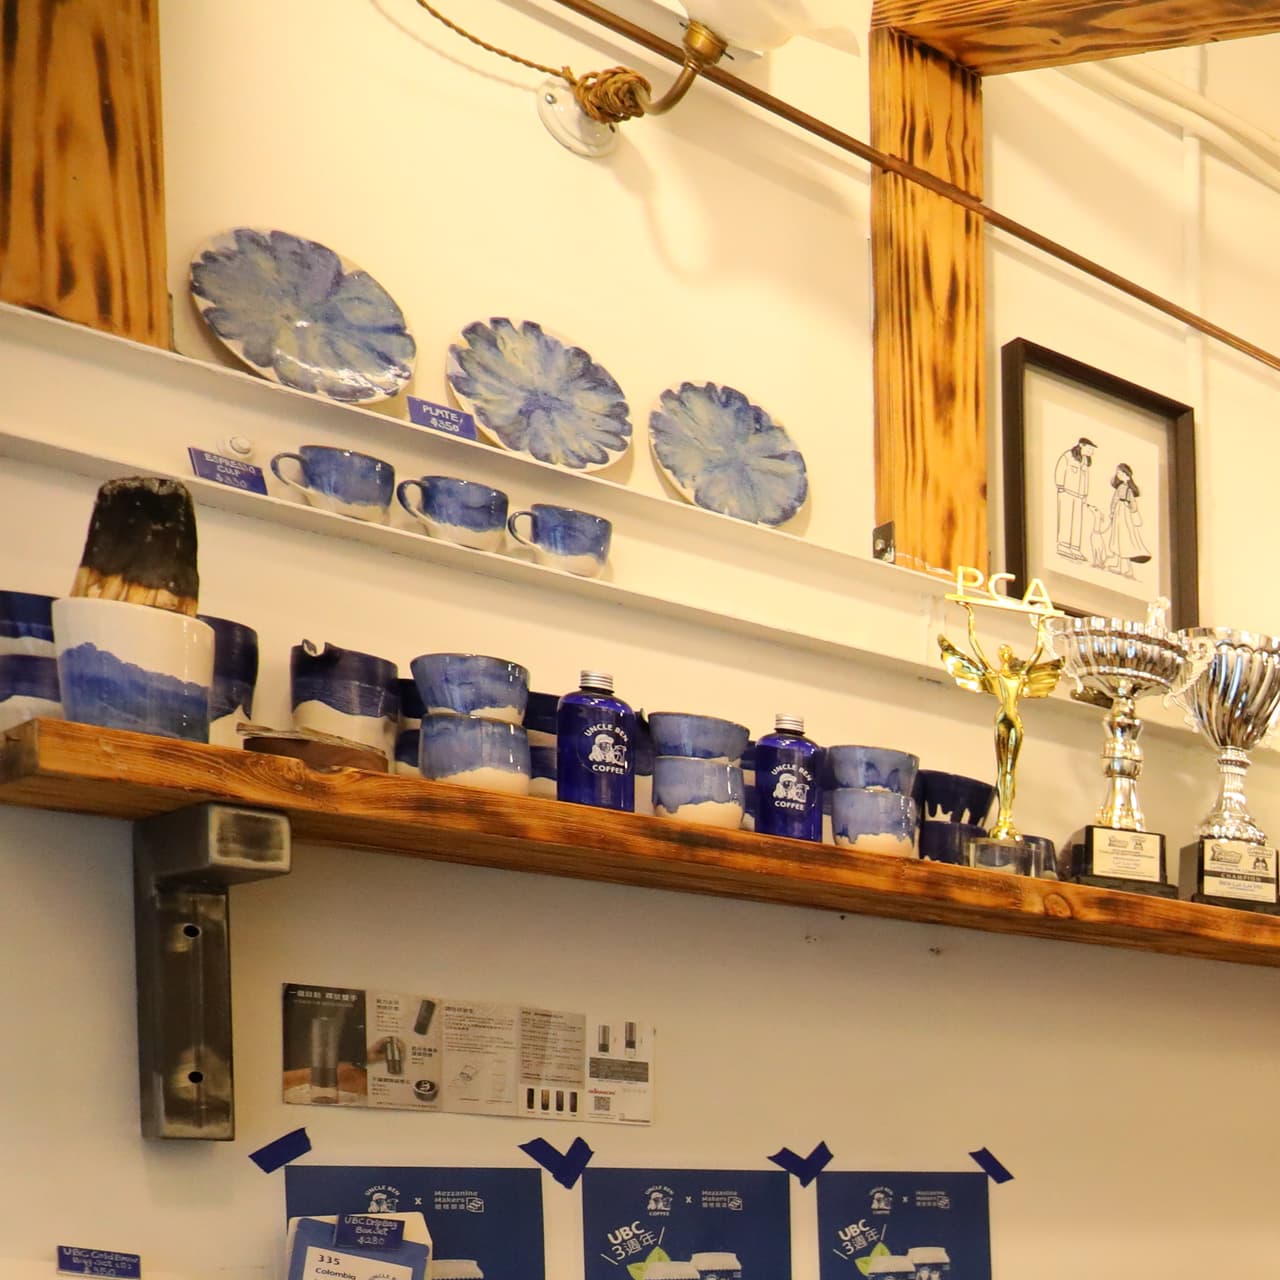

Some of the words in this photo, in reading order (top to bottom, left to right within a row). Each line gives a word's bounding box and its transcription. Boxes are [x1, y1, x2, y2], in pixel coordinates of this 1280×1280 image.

[584, 723, 614, 738] UNCLE
[613, 726, 630, 743] BEN
[591, 763, 625, 776] COFFEE
[770, 763, 798, 776] UNCLE
[798, 767, 814, 781] BEN
[774, 800, 805, 811] COFFEE
[364, 1184, 386, 1196] UNCLE
[607, 1220, 646, 1245] UBC
[838, 1218, 870, 1241] UBC
[611, 1230, 658, 1261] 3週年
[841, 1228, 881, 1256] 3週年
[318, 1254, 341, 1266] 335
[315, 1267, 357, 1280] Colombia
